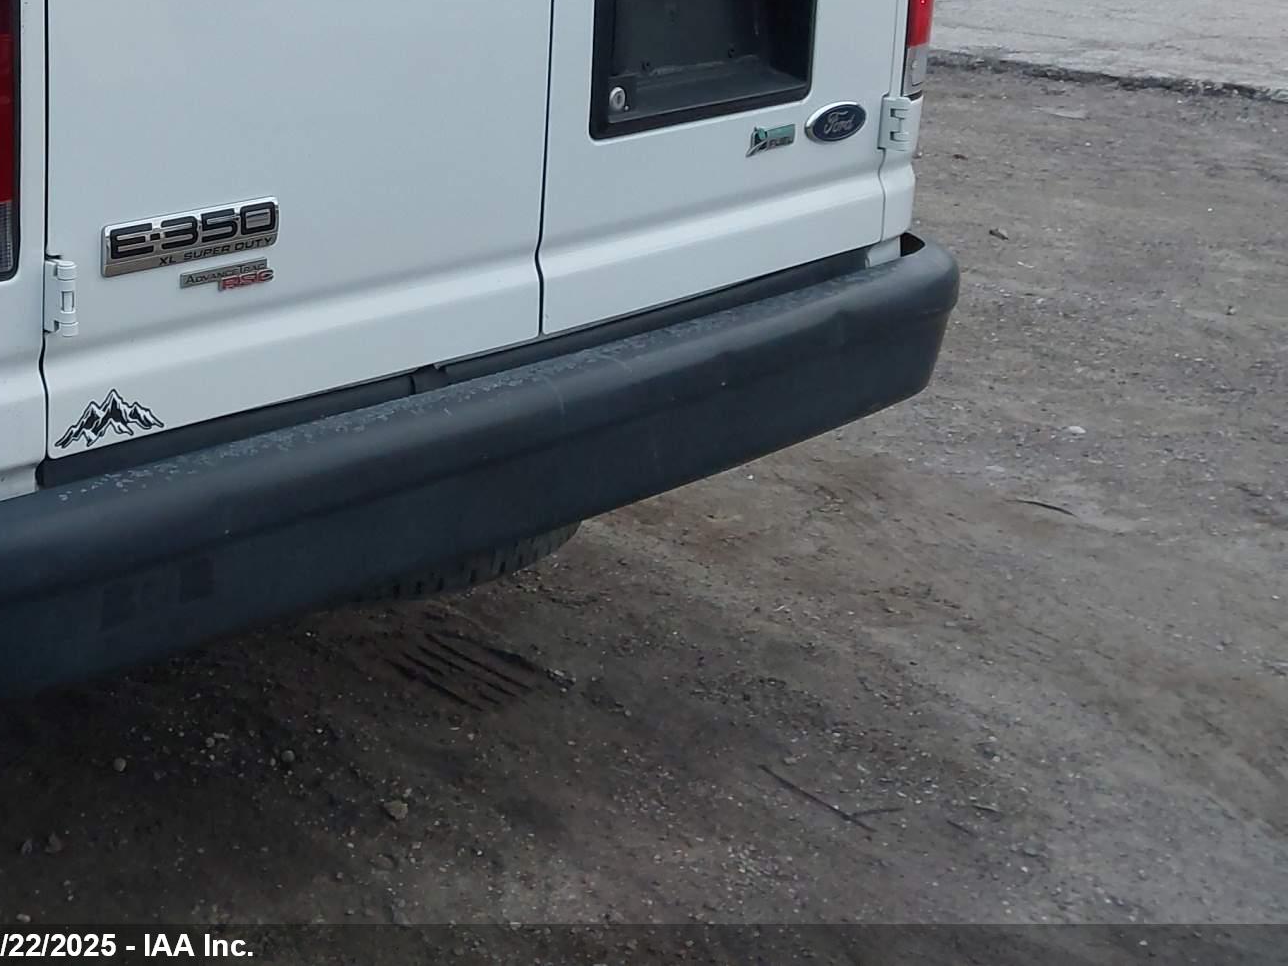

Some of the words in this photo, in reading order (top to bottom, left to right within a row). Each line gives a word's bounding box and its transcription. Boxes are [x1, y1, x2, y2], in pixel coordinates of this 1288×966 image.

[824, 111, 855, 135] Ford
[110, 201, 276, 260] E-350
[159, 256, 177, 266] XL
[183, 244, 231, 261] SUPER
[234, 237, 273, 251] DUTY
[221, 268, 274, 291] RSC
